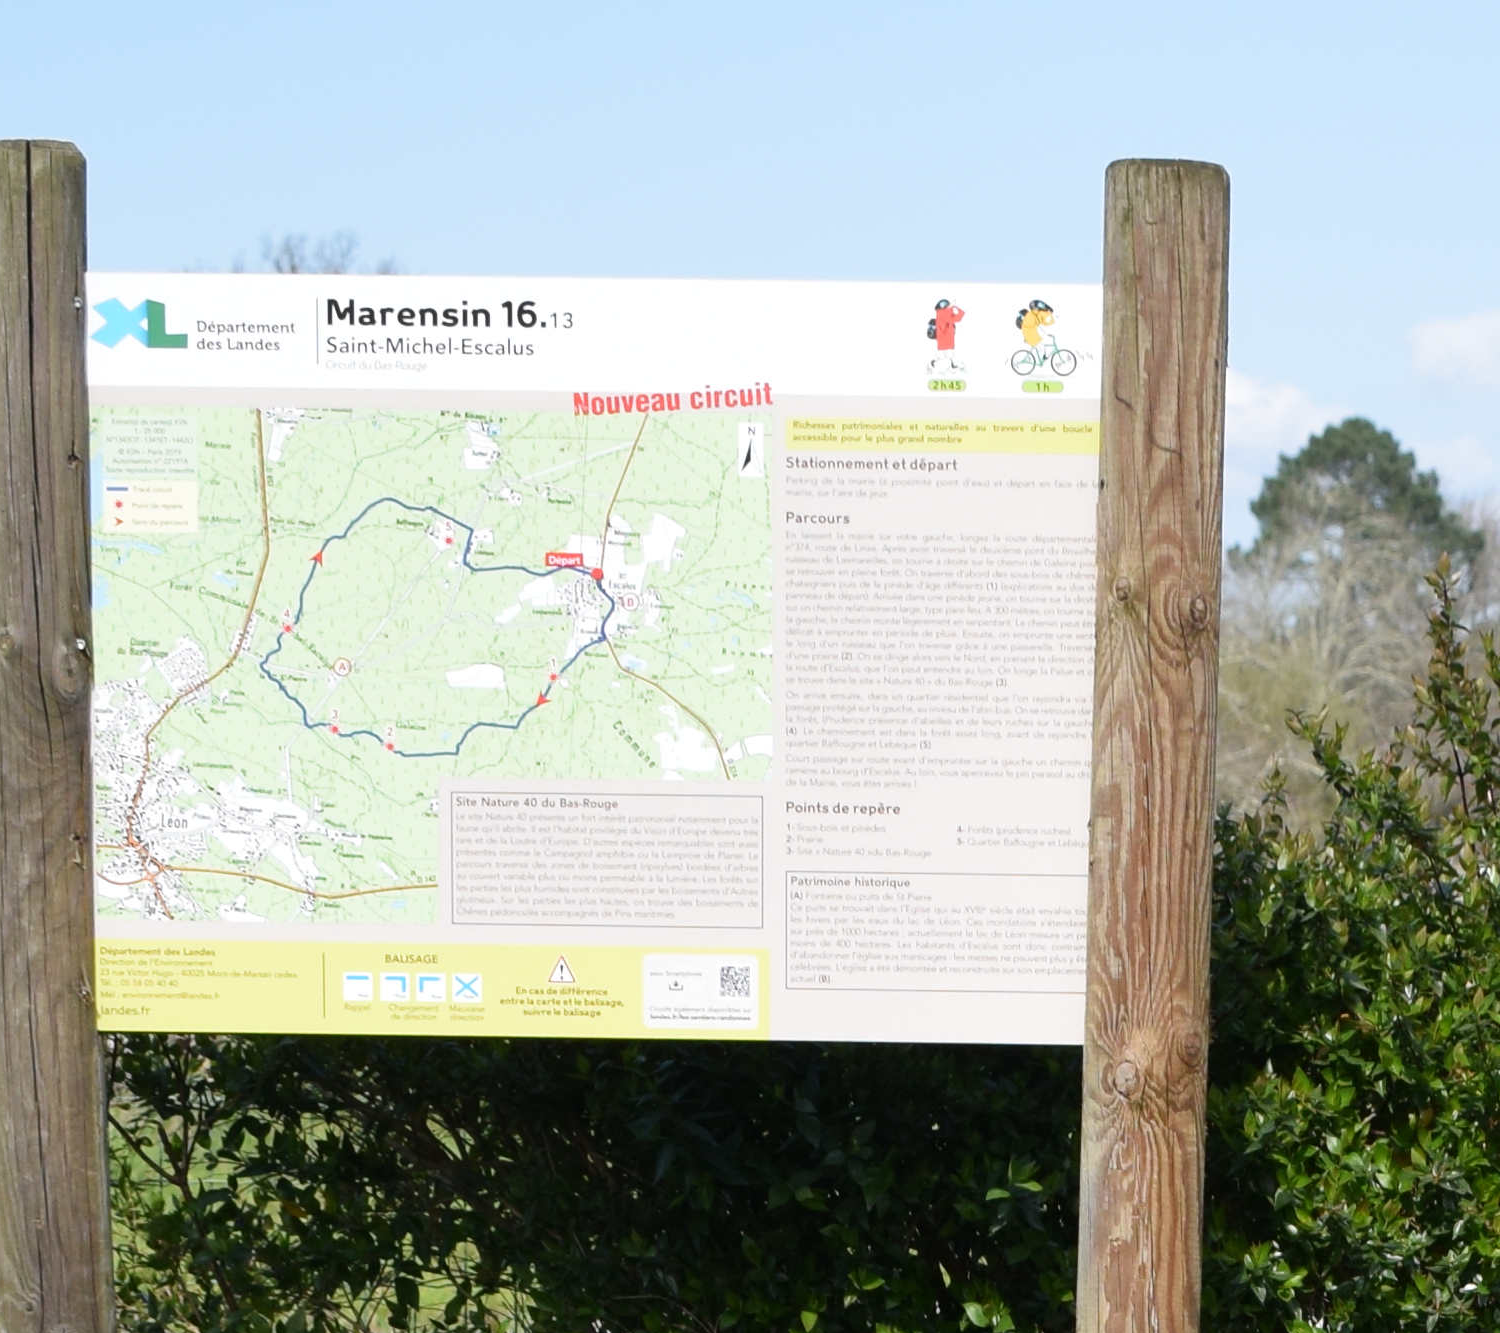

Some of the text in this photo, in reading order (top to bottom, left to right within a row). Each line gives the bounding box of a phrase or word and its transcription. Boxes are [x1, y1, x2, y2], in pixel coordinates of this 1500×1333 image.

[327, 298, 491, 328] Marensin
[196, 319, 295, 338] Département
[196, 337, 280, 351] des Landes
[327, 336, 534, 357] Saint-Michel-Escalus
[573, 382, 774, 416] Nouveau circuit
[747, 426, 756, 435] N
[786, 456, 958, 474] Stationnement et départ
[785, 511, 850, 525] Parcours
[445, 521, 452, 531] 5
[548, 554, 581, 566] Départ
[283, 609, 290, 617] 4
[338, 663, 346, 671] A
[331, 710, 338, 719] 3
[386, 727, 393, 736] 2
[455, 797, 619, 811] Site Nature 40 du Bas-Rouge
[785, 801, 901, 818] Points de repère
[790, 876, 911, 890] Patrimoine historique
[100, 947, 216, 958] Département des Landes
[384, 954, 439, 965] BALISAGE
[100, 1005, 151, 1016] landes.fr
